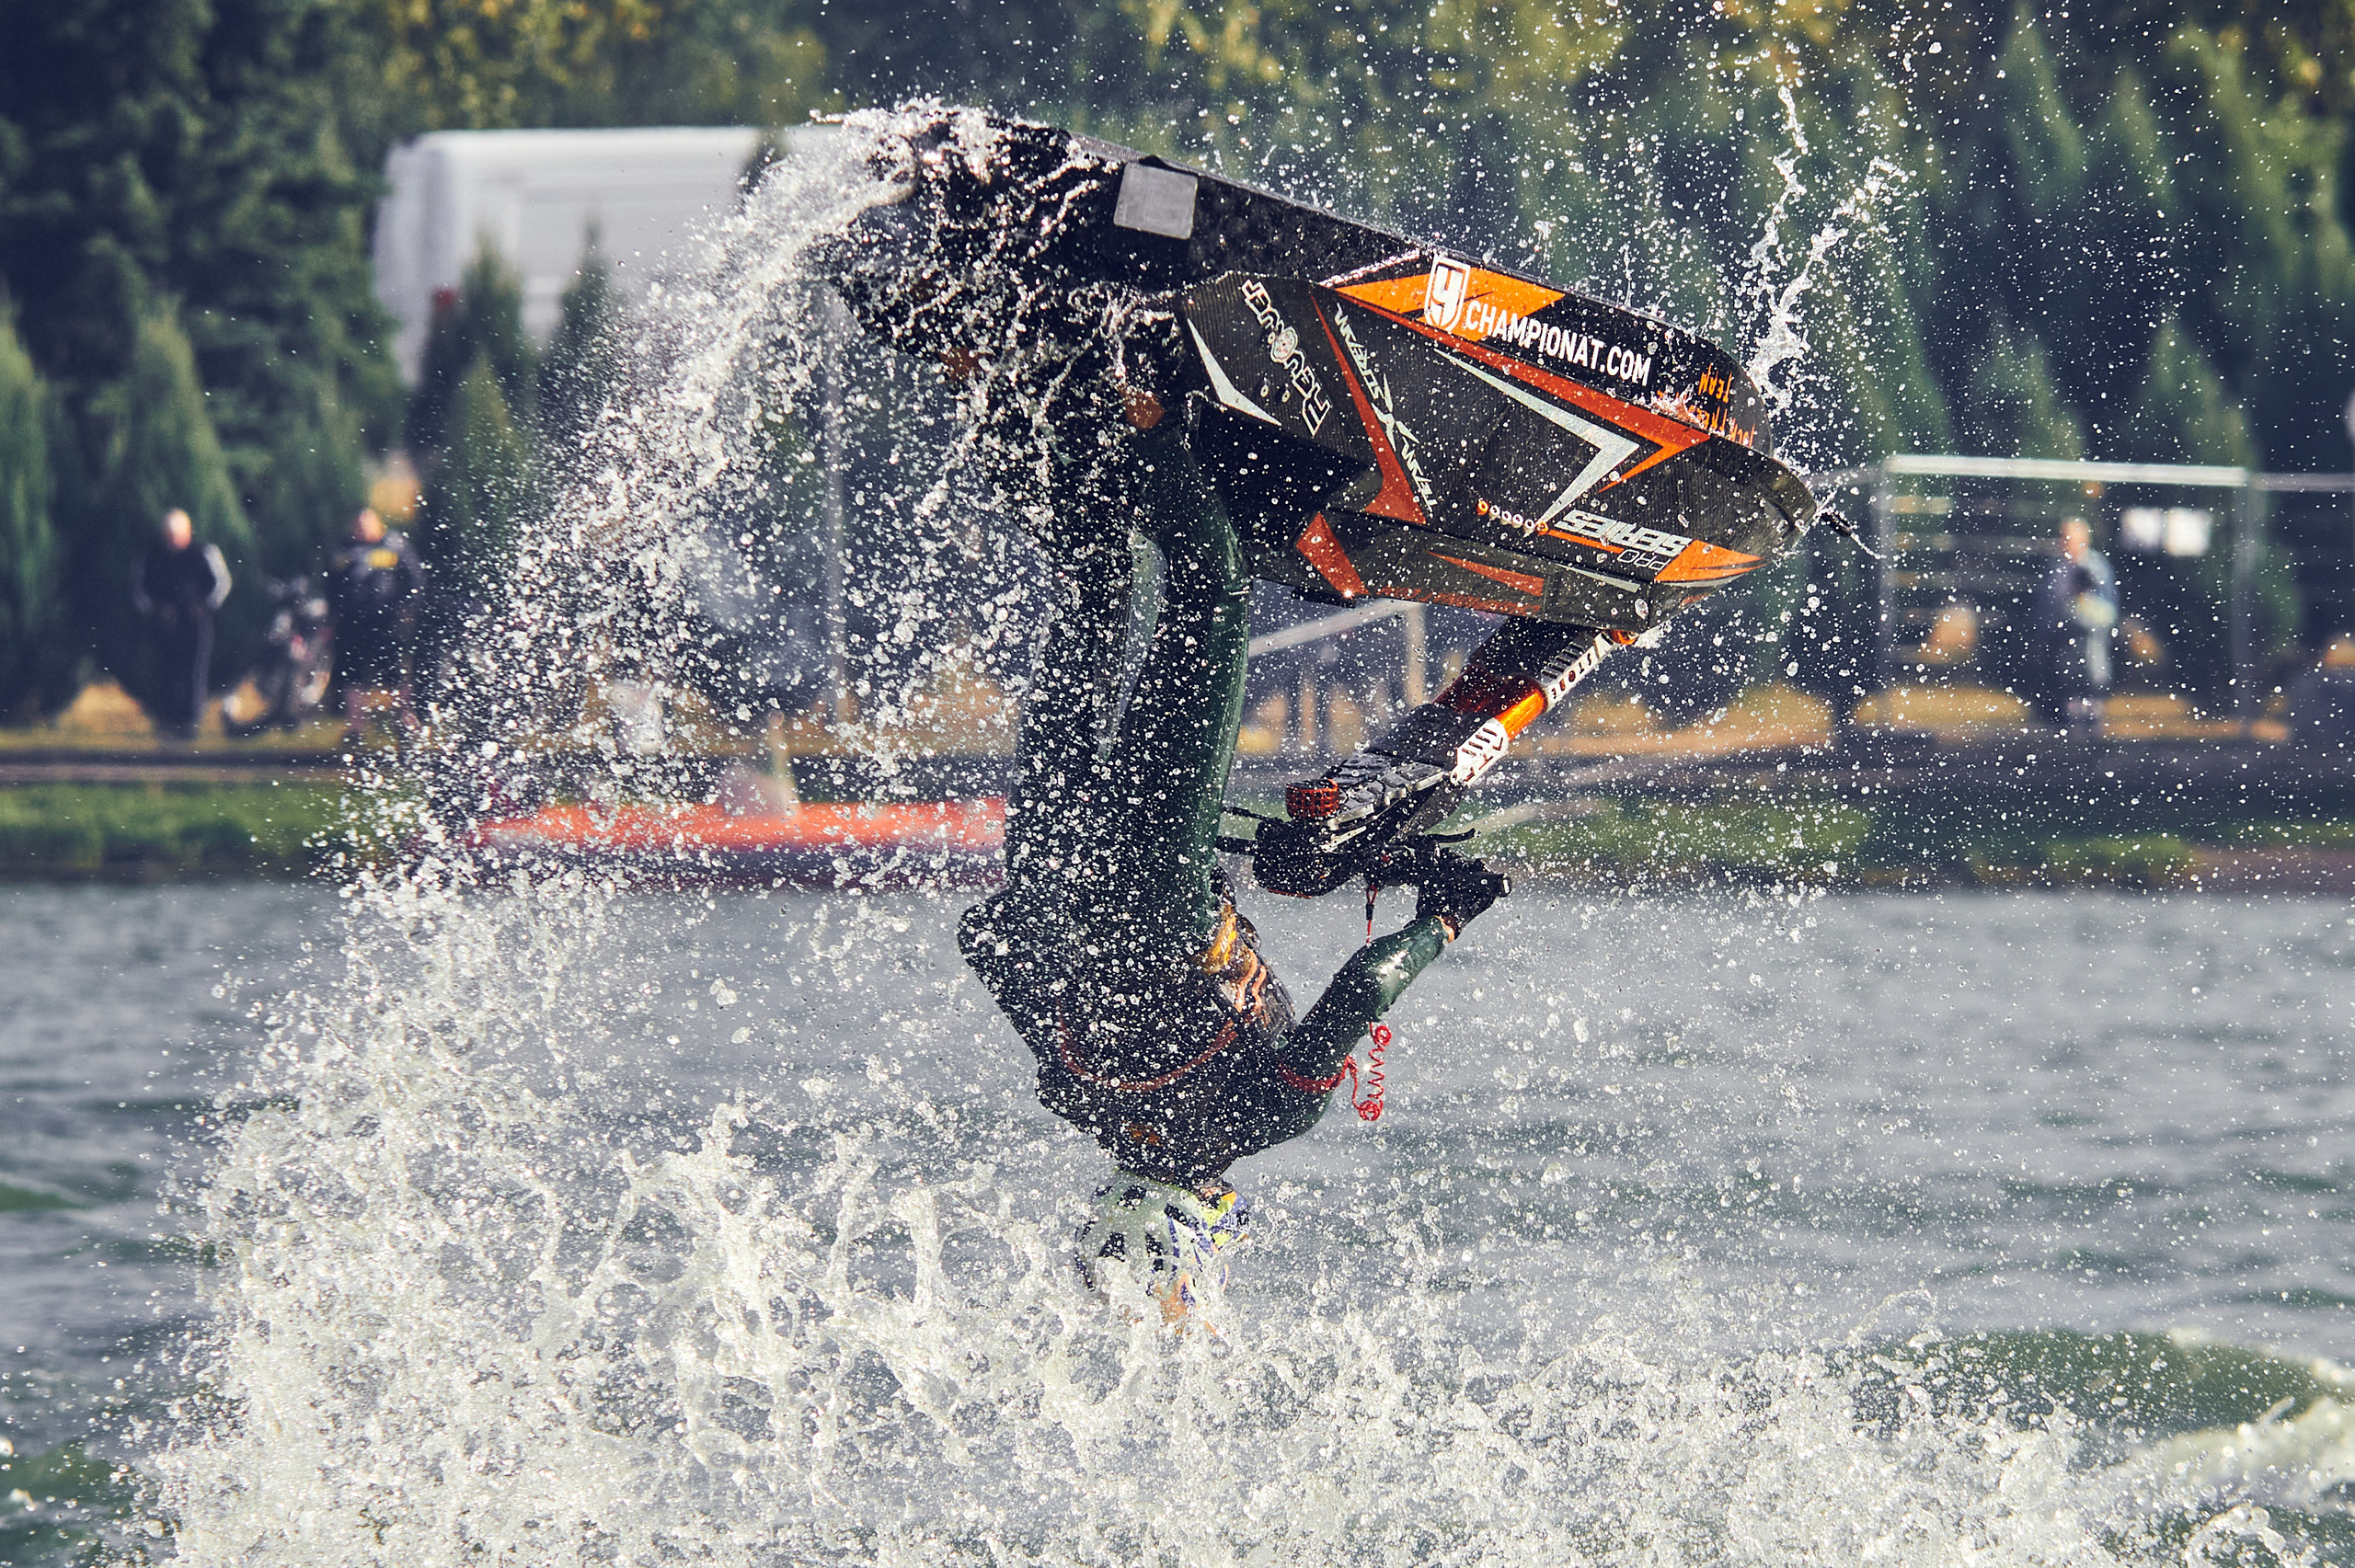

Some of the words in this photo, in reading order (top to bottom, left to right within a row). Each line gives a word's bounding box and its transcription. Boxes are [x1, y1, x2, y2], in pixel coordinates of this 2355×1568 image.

[1465, 299, 1652, 387] CHAMPIONAT.COM
[1697, 363, 1733, 404] TEAM
[1554, 509, 1693, 557] SERIES
[1616, 548, 1671, 571] PRO
